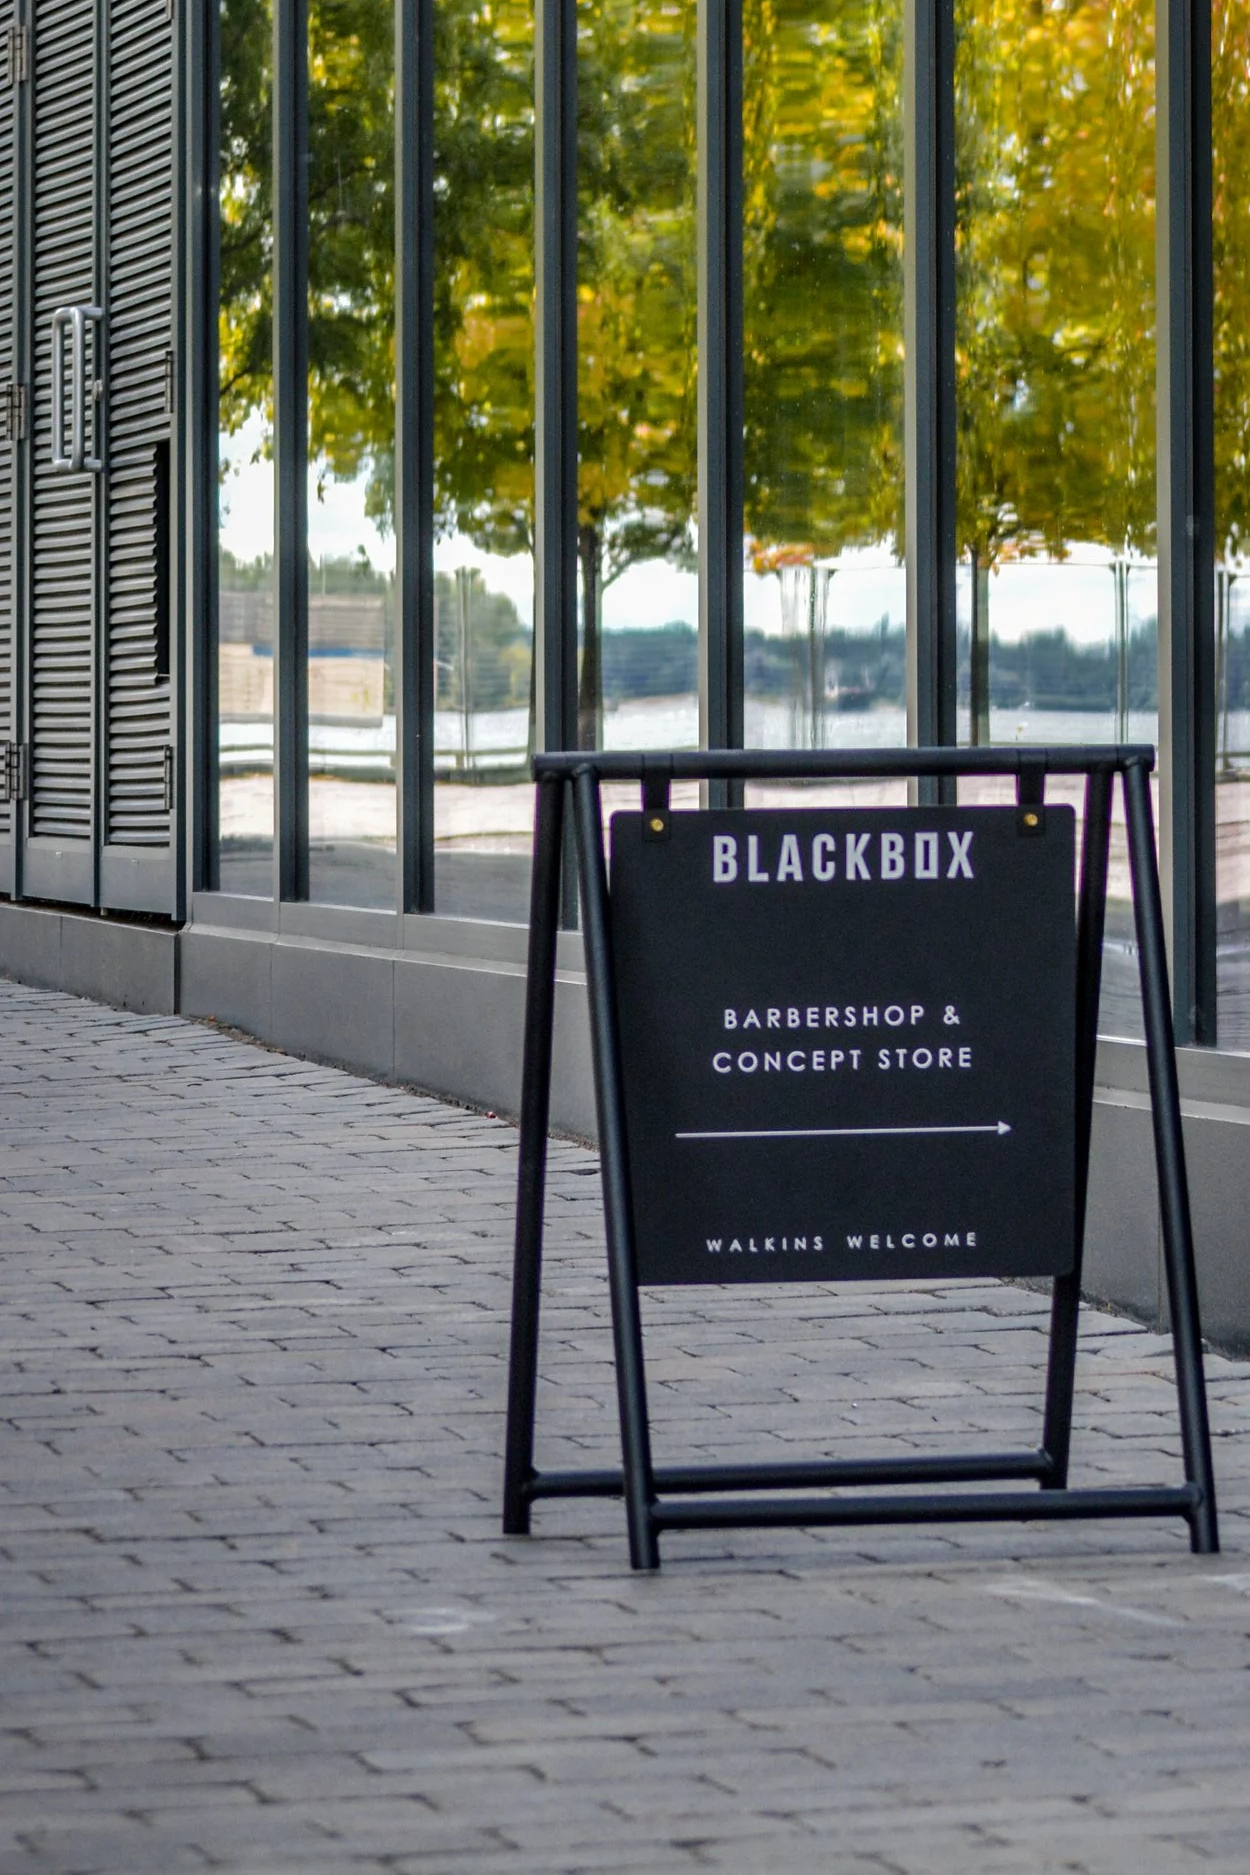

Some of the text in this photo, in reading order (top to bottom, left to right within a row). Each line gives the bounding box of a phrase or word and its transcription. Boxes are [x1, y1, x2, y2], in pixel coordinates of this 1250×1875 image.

[713, 831, 975, 883] BLACKBOX
[724, 1004, 961, 1030] BARBERSHOP &
[712, 1046, 973, 1074] CONCEPT STORE
[706, 1231, 977, 1253] WALKINS WELCOME
